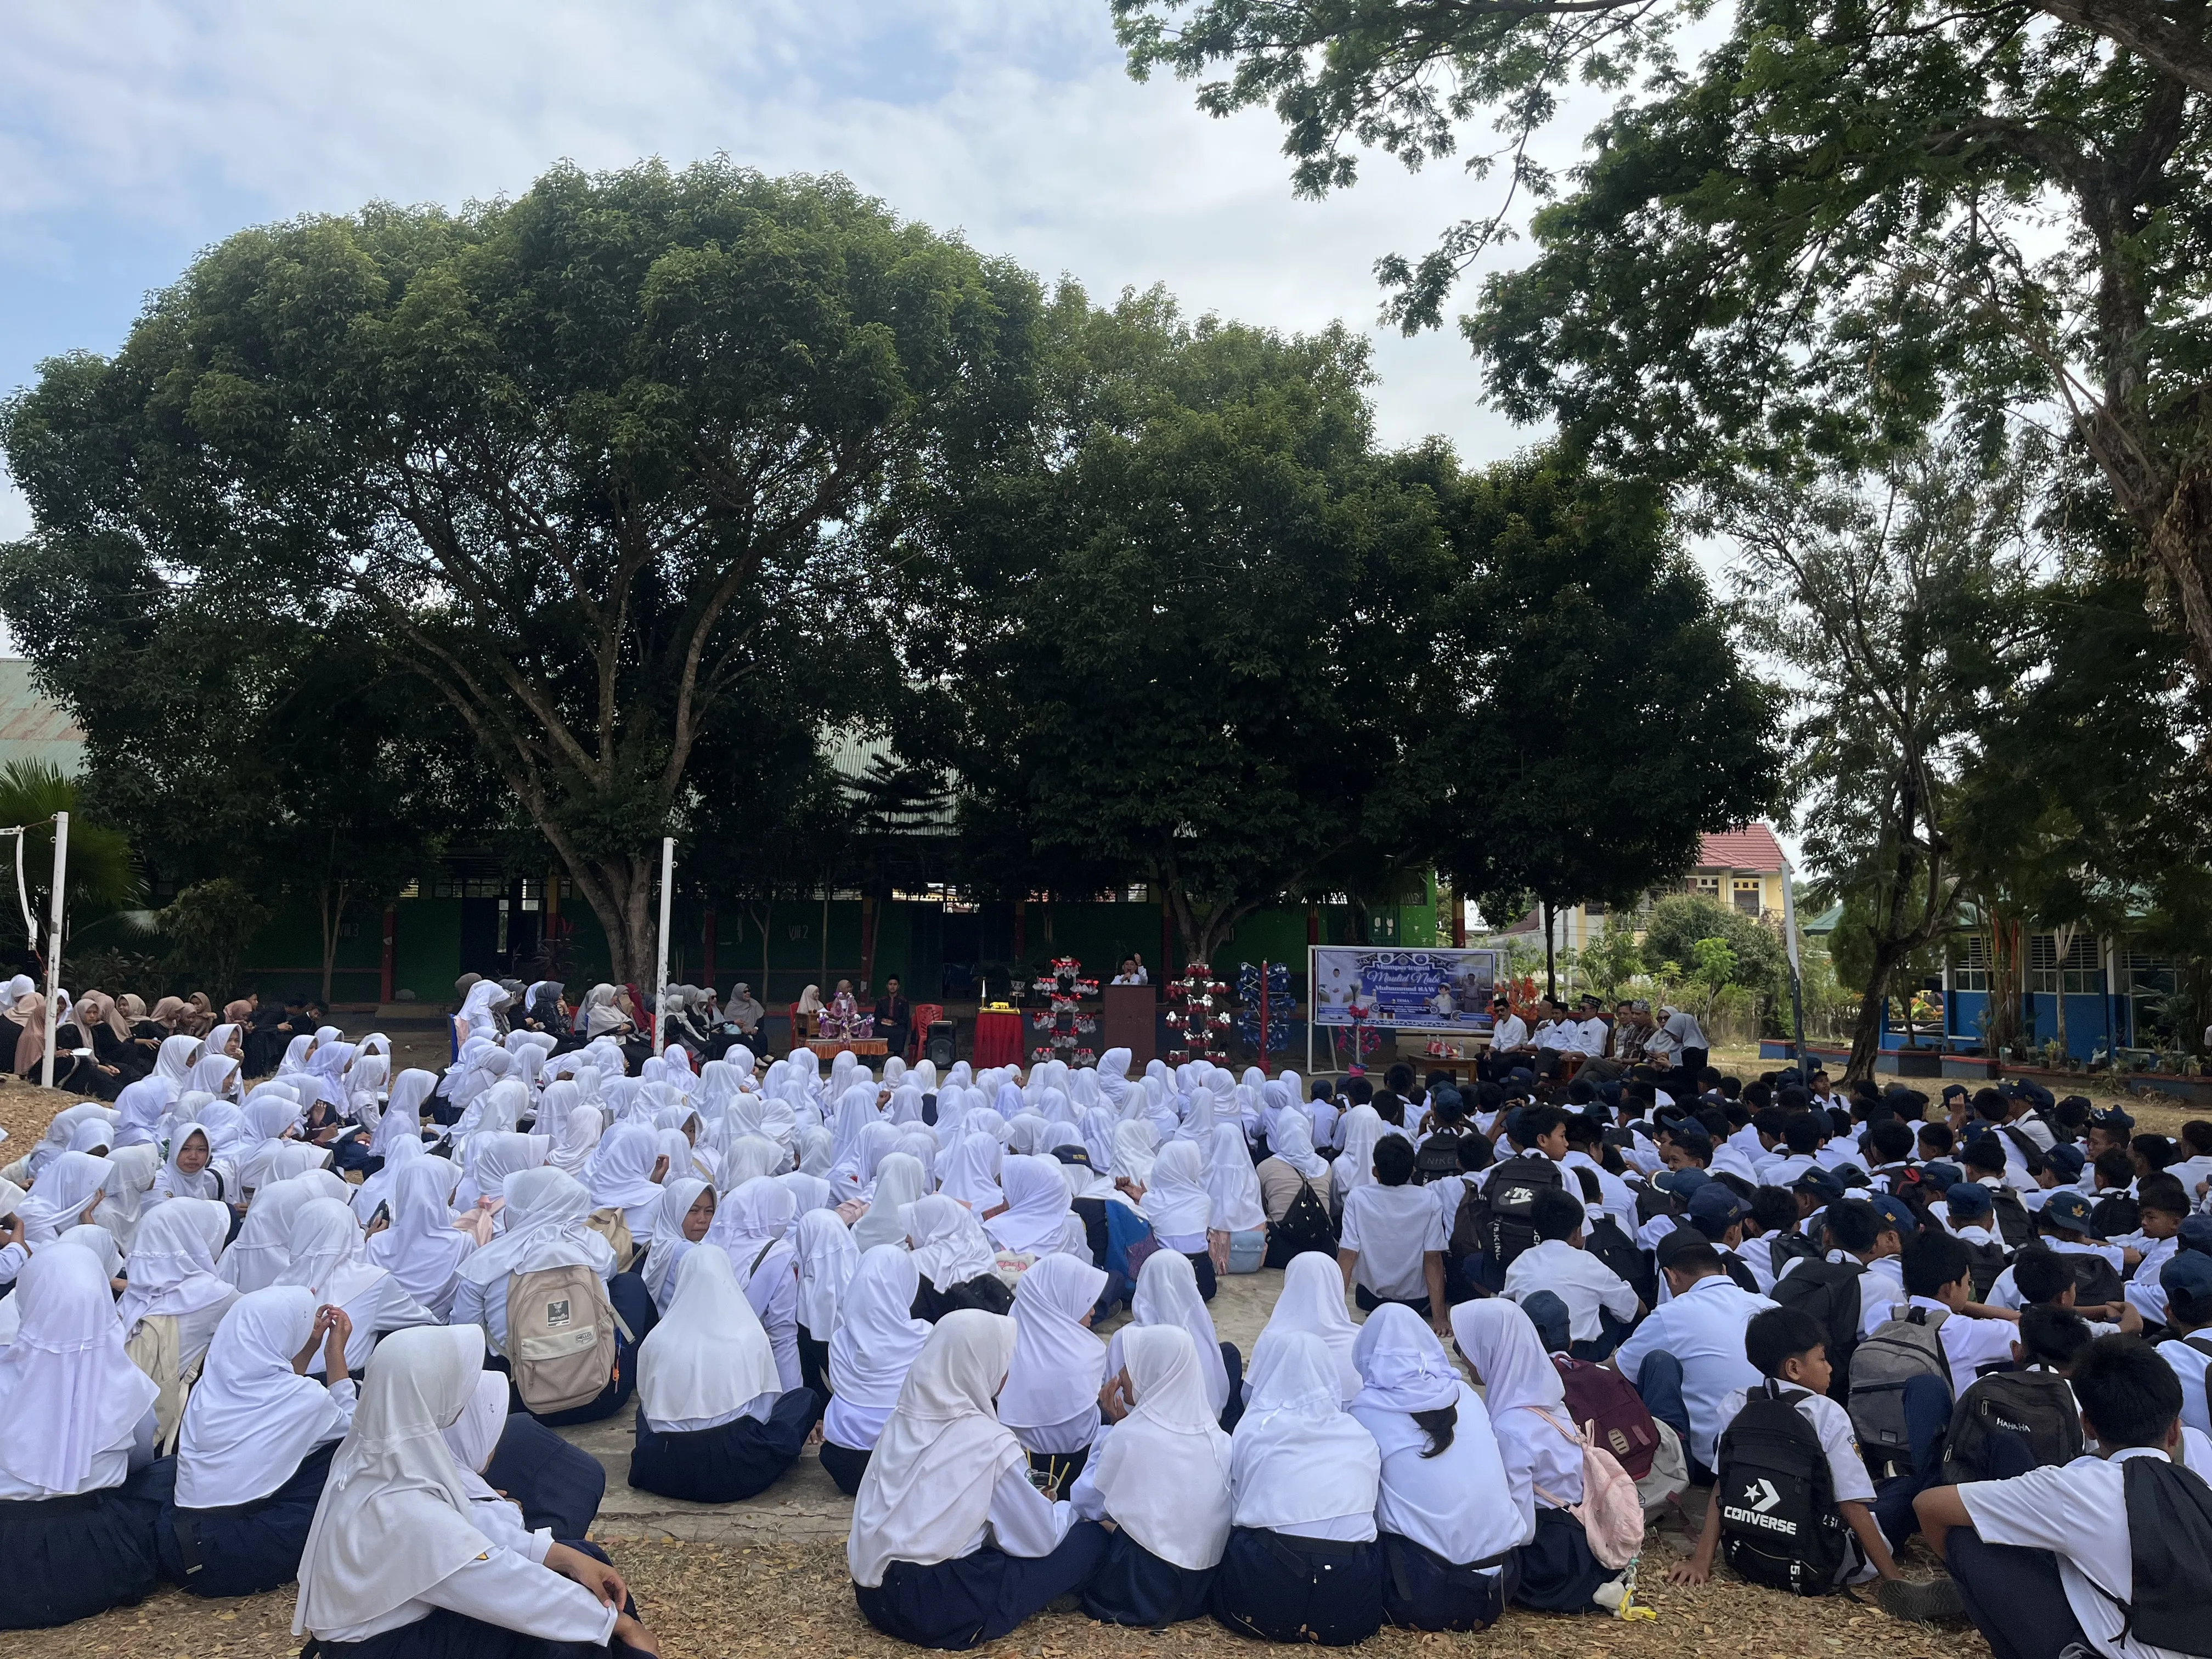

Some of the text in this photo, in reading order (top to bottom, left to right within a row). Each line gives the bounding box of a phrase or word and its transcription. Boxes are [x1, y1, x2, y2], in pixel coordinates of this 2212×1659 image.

[1367, 970, 1441, 984] Maulid Nabi
[1427, 1156, 1454, 1165] NIKE
[1724, 1505, 1797, 1536] CONVERSE
